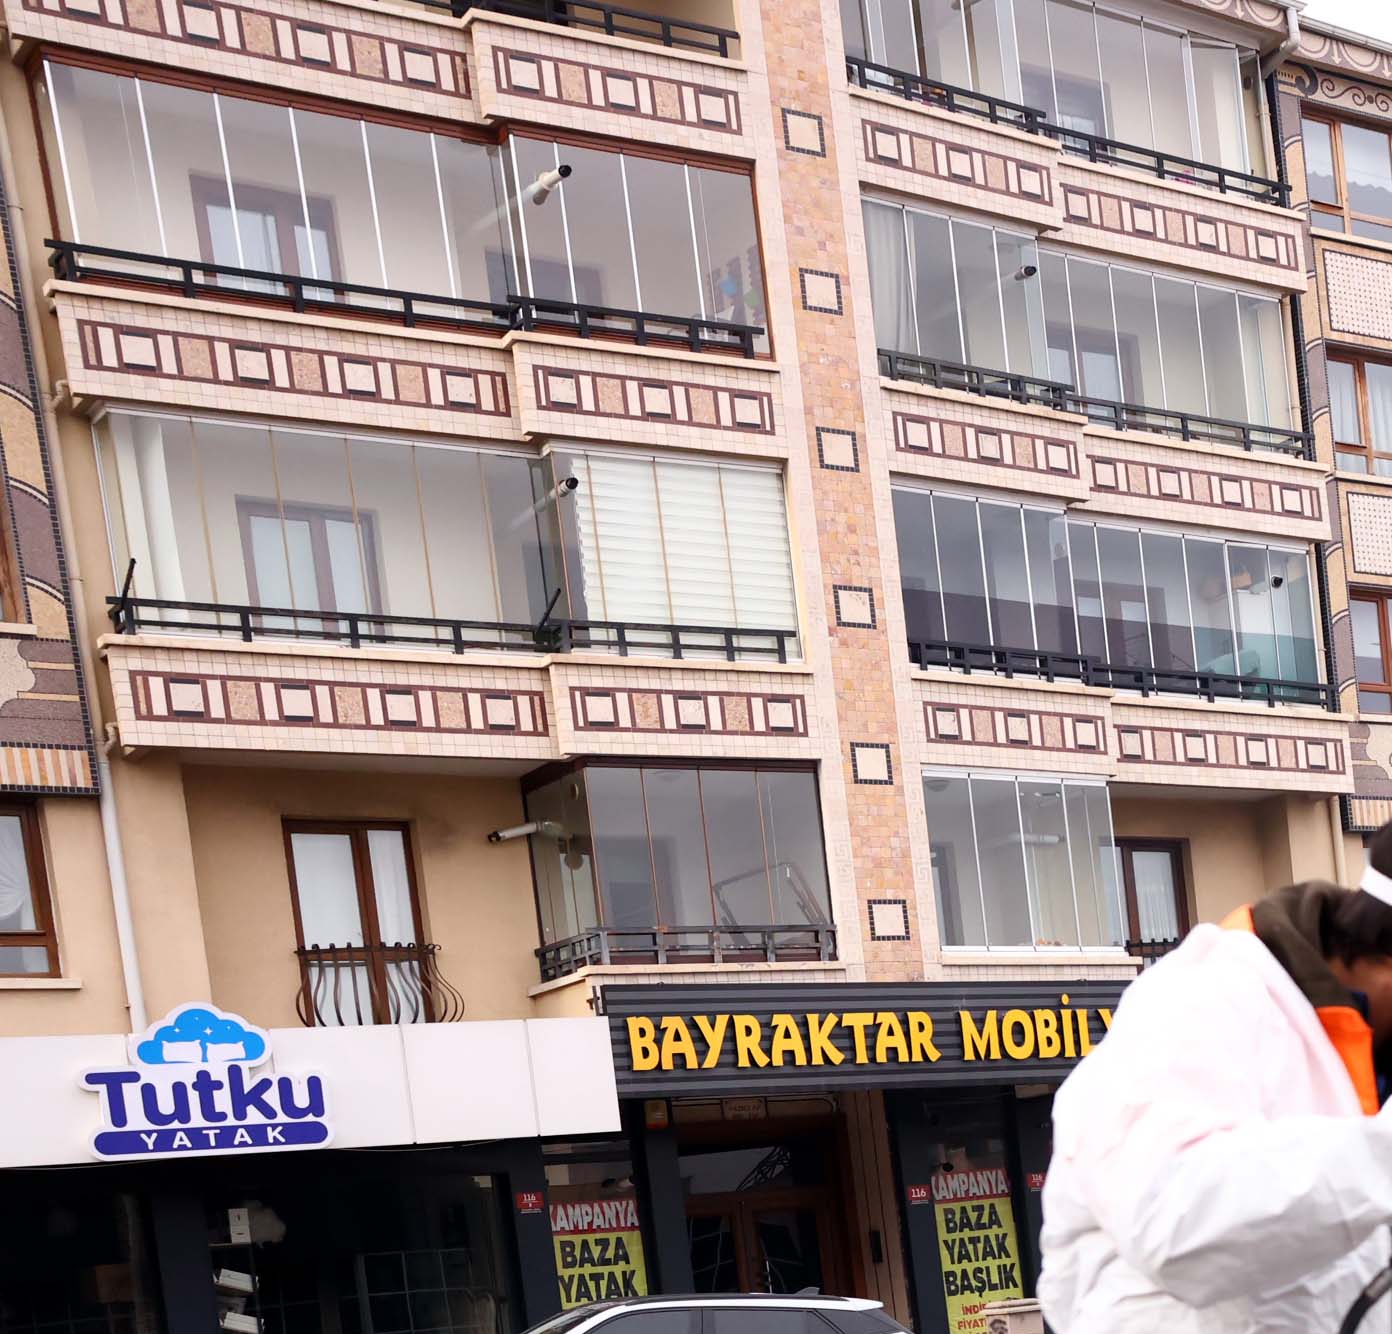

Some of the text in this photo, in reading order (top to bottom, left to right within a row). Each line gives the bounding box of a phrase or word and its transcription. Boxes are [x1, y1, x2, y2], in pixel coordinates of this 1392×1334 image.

[626, 1010, 942, 1071] BAYRAKTAR
[84, 1064, 325, 1129] Tutku
[140, 1126, 286, 1150] YATAK
[911, 1188, 927, 1198] 116
[943, 1203, 1003, 1234] BAZA
[559, 1237, 630, 1269] BAZA
[943, 1233, 1012, 1265] YATAK
[558, 1270, 640, 1303] YATAK
[944, 1263, 1019, 1298] BAŞLIK
[957, 1317, 987, 1330] FİYAT
